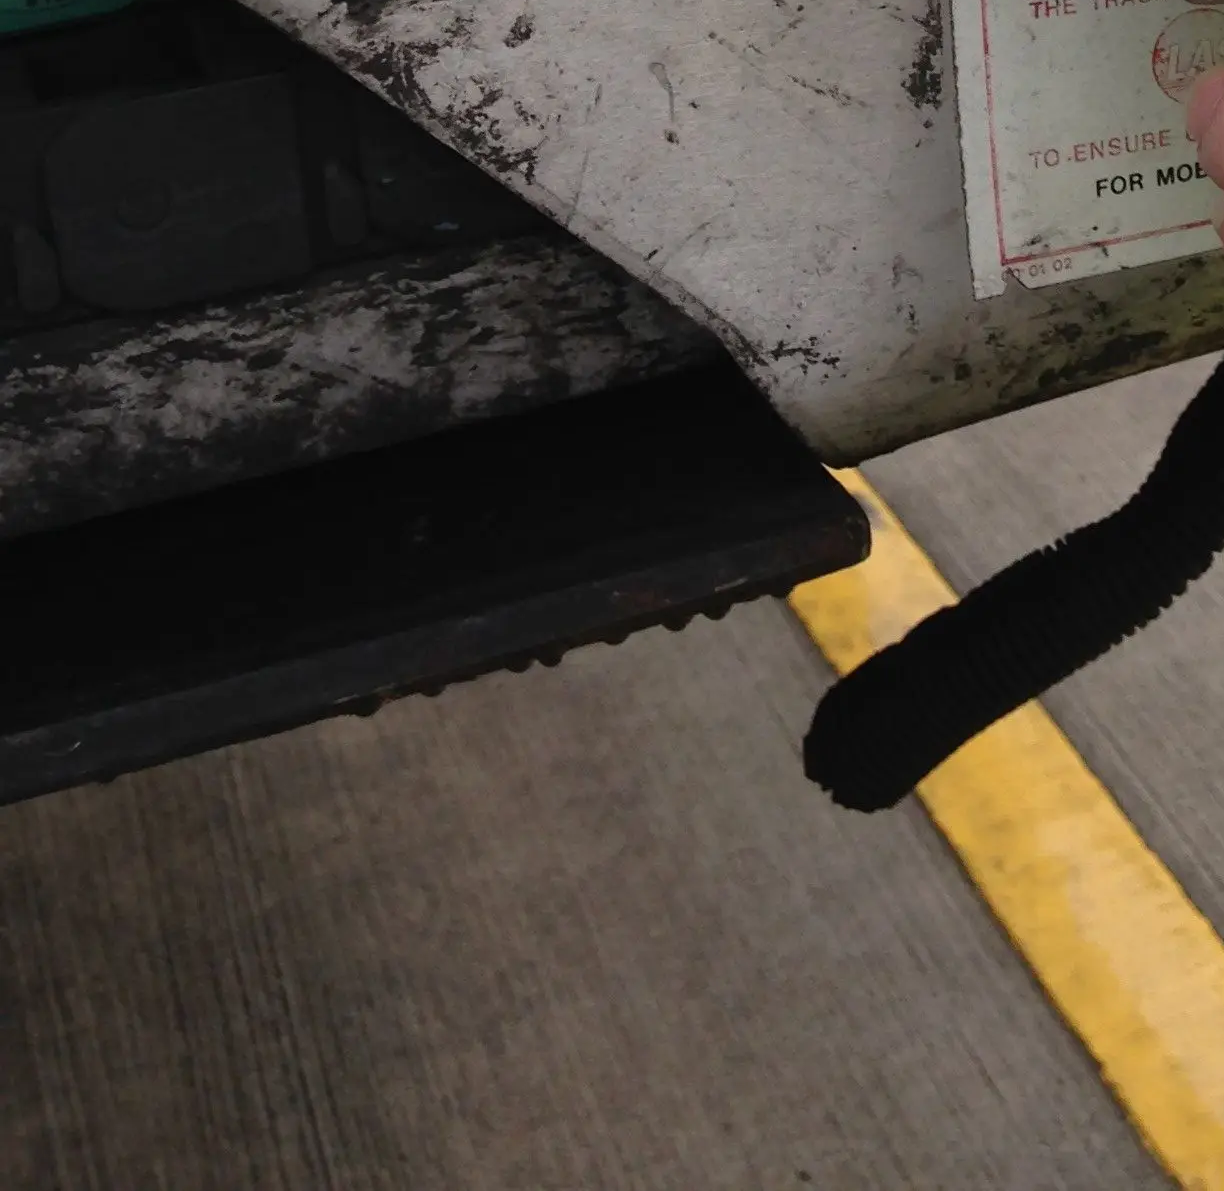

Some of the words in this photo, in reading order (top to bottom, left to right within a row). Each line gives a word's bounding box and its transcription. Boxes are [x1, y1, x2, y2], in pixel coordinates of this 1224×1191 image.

[1028, 148, 1060, 169] TO
[1073, 129, 1171, 163] ENSURE
[1096, 172, 1144, 198] FOR
